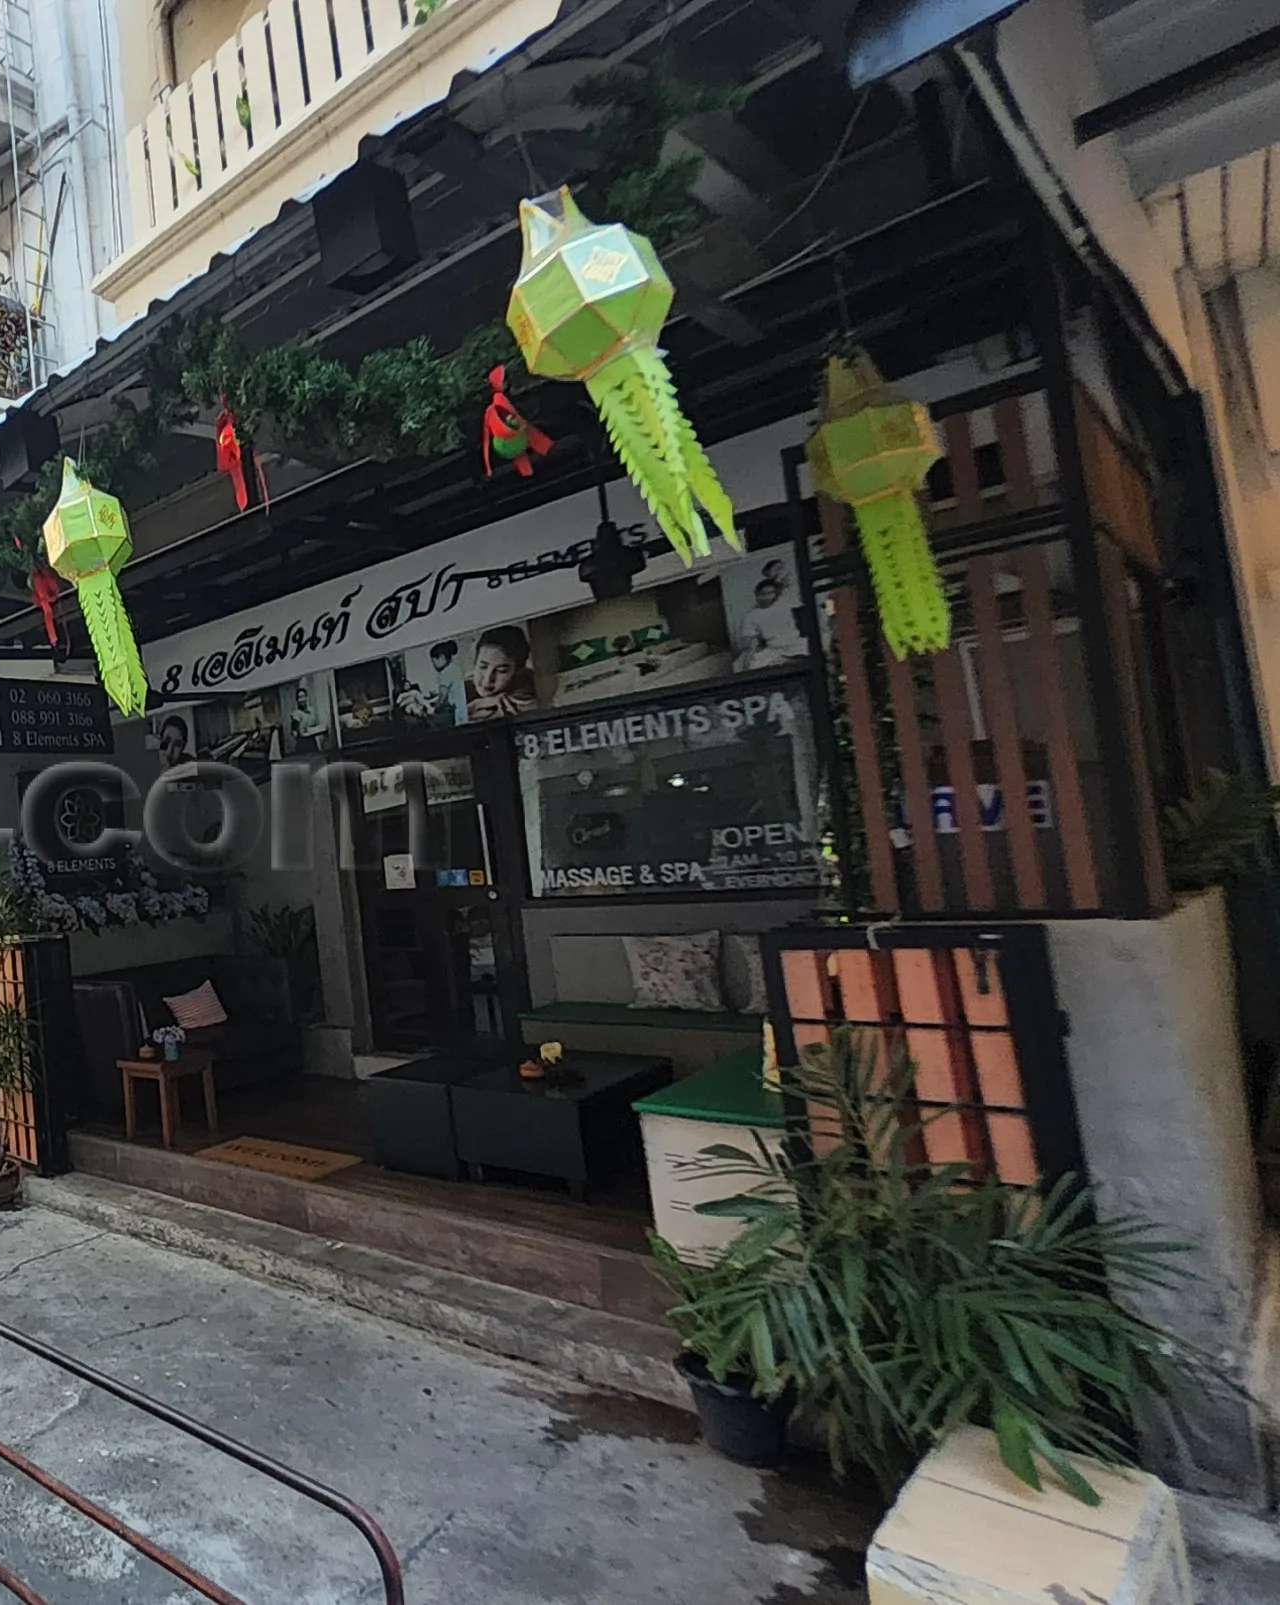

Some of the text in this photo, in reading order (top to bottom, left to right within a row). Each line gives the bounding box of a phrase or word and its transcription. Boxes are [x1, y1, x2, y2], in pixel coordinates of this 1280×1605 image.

[9, 688, 92, 707] 02 060 3166
[11, 710, 36, 725] 088
[40, 711, 61, 725] 991
[523, 691, 795, 758] 8 ELEMENTS SPA
[12, 730, 106, 747] 8 Elements SPA
[721, 822, 810, 849] OPEN
[46, 857, 117, 874] 8 ELEMENTS
[543, 861, 706, 888] MASSAGE & SPA
